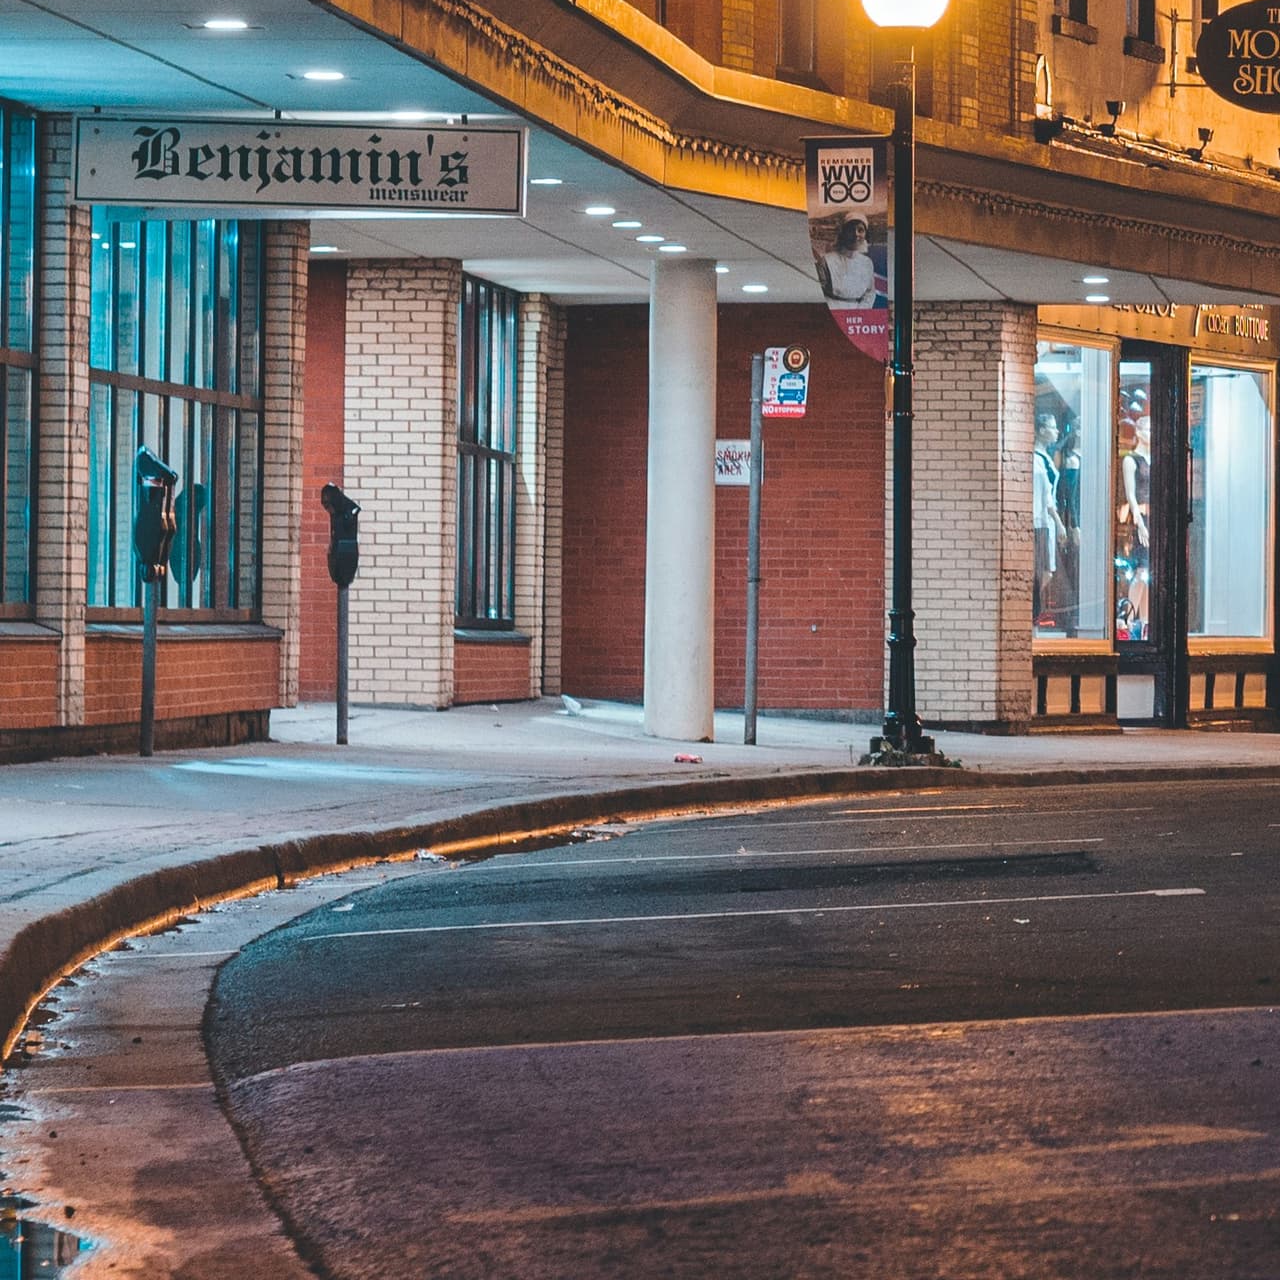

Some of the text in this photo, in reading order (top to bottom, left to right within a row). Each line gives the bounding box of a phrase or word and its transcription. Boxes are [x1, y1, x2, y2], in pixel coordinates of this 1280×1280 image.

[131, 125, 470, 194] Benjamin's
[821, 165, 871, 186] WWI
[369, 186, 469, 202] menswear
[821, 181, 871, 204] 100
[848, 325, 885, 334] STORY
[1235, 315, 1268, 344] BOUTIQUE
[762, 405, 774, 414] NO
